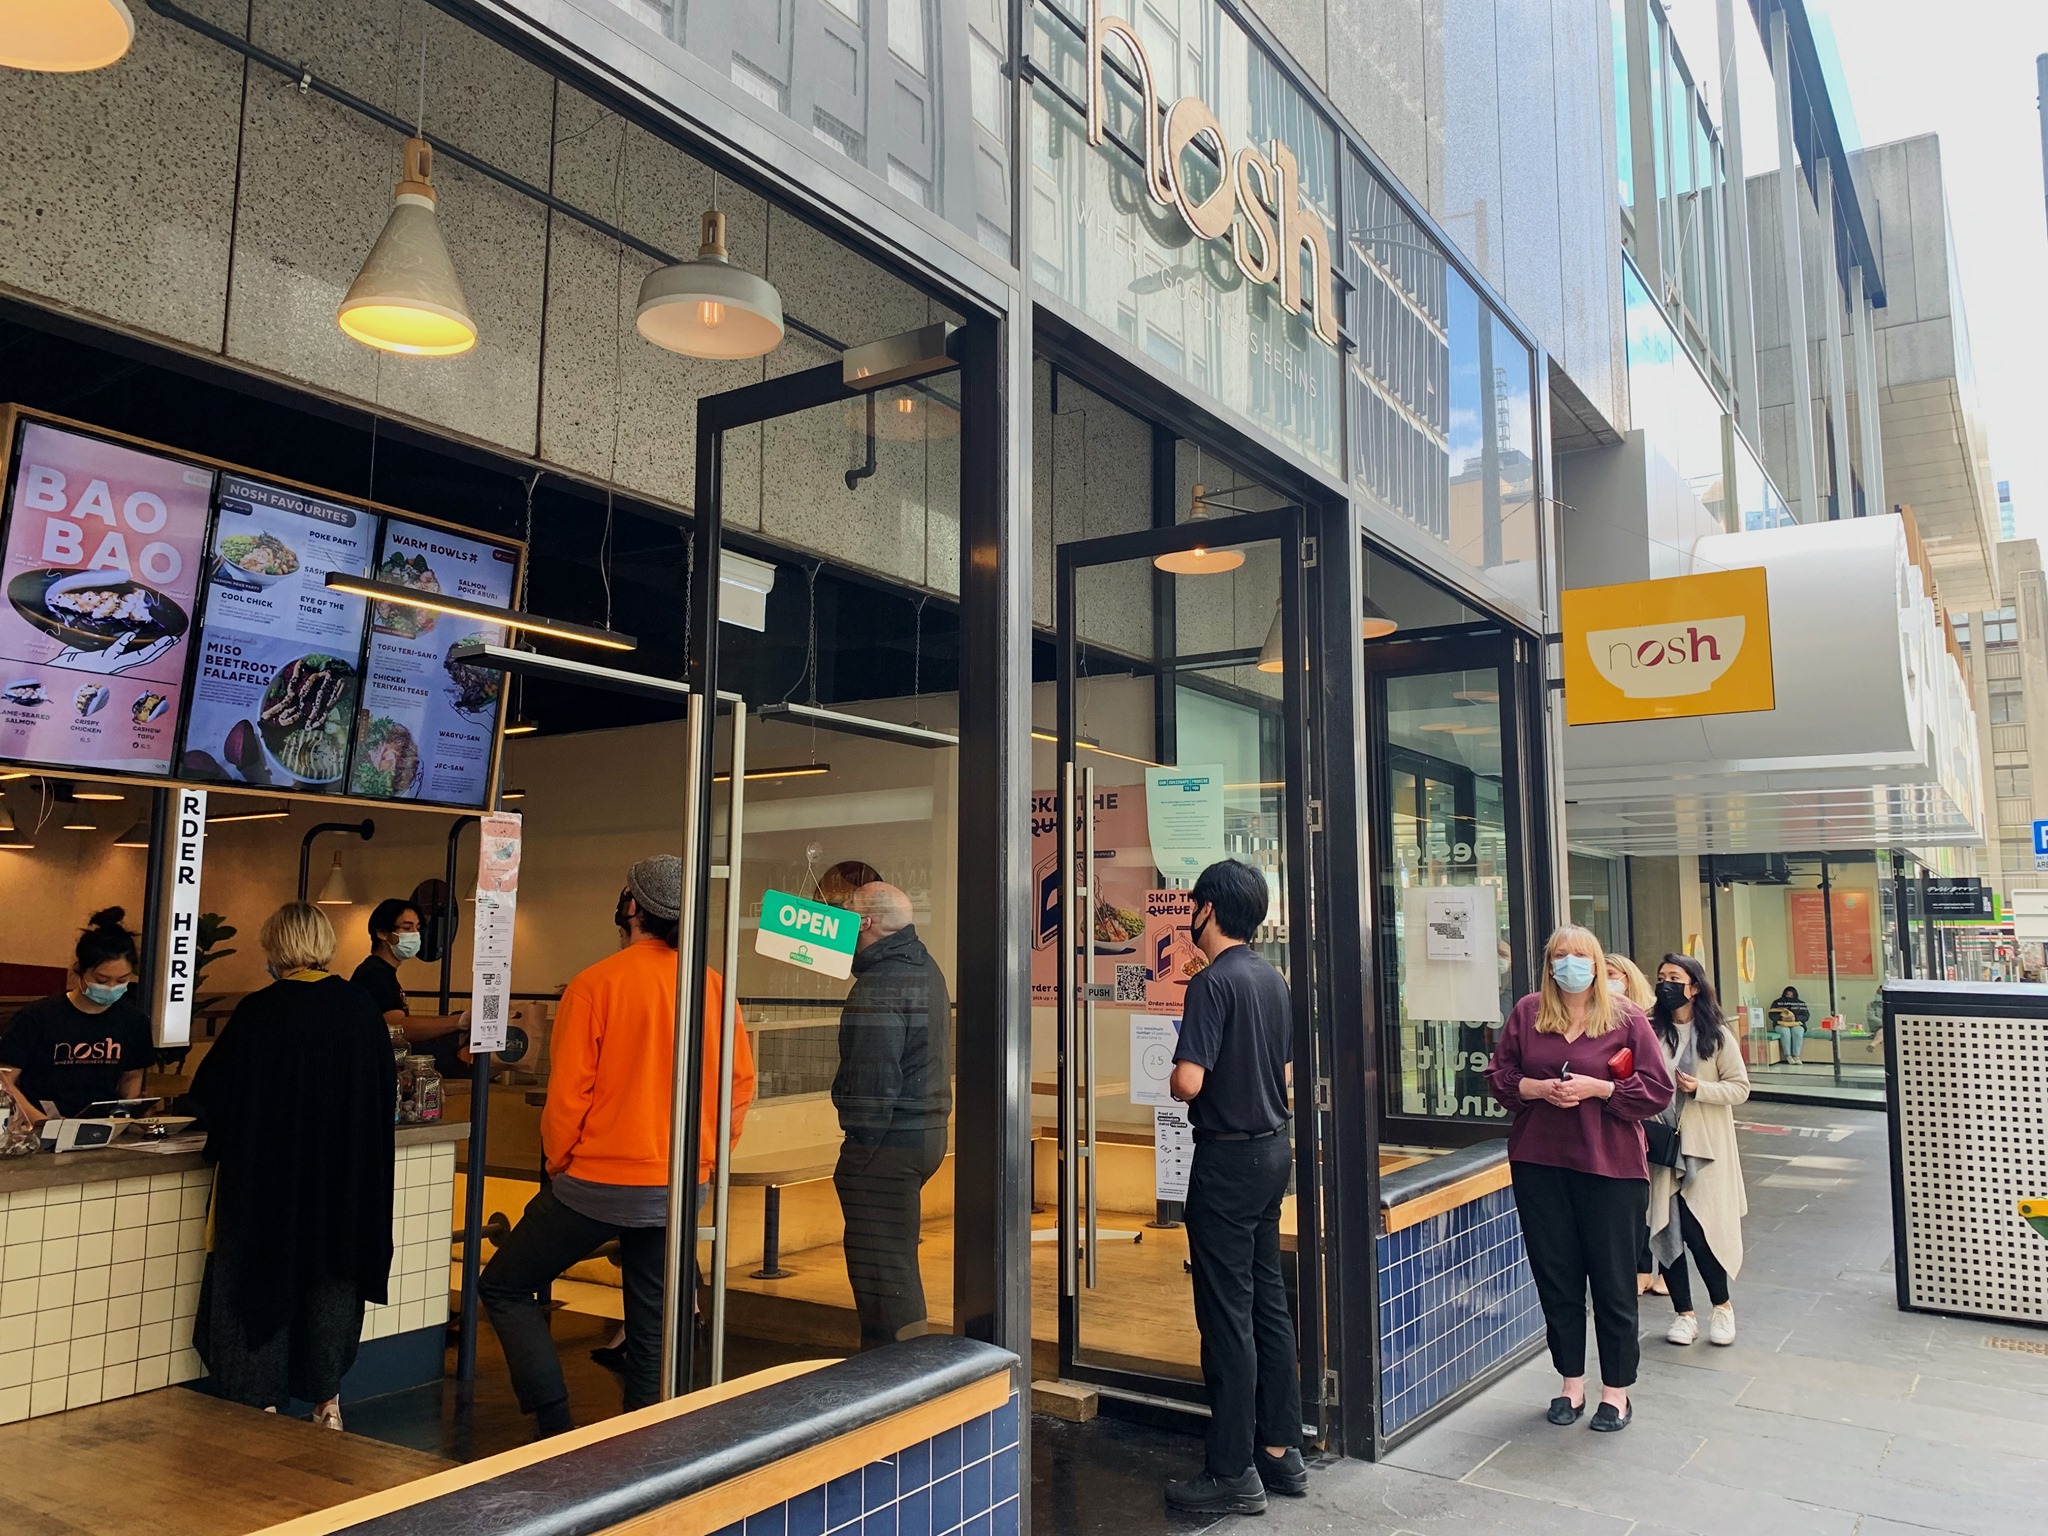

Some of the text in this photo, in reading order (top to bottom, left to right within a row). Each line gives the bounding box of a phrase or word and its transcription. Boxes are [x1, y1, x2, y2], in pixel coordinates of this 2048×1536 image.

[1085, 0, 1338, 348] nosh
[1074, 196, 1317, 399] WHERE GOODNESS BEGINS
[24, 464, 168, 534] BAO
[229, 484, 348, 524] NOSH FAVOURITES
[309, 530, 358, 548] POKE PARTY
[41, 517, 182, 584] BAO
[392, 533, 428, 551] WARM
[430, 544, 468, 561] BOWLS
[304, 566, 327, 576] SASH
[457, 585, 498, 600] POKE ABURI
[458, 579, 487, 591] SALMON
[221, 592, 274, 608] COOL CHICK
[300, 595, 345, 610] EYE OF THE
[299, 605, 323, 615] TIGER
[207, 641, 242, 656] MISO
[377, 643, 432, 659] TOFU TERI-SAN
[1608, 627, 1721, 670] nosh
[205, 654, 278, 675] BEETROOT
[203, 667, 271, 686] FALAFELS
[373, 672, 407, 684] CHICKEN
[372, 681, 430, 697] TERIYAKI TEASE
[0, 710, 51, 721] AME-SEARED
[5, 718, 37, 726] SALMON
[74, 719, 100, 727] CRISPY
[70, 725, 102, 734] CHICKEN
[132, 725, 162, 734] CASHEW
[137, 733, 156, 741] TOFU
[439, 730, 481, 742] WAGYU-SAN
[434, 763, 465, 772] JFC-SAN
[177, 789, 201, 886] RDER
[1148, 893, 1177, 903] SKIP
[1148, 905, 1191, 917] QUEUE
[779, 904, 840, 940] OPEN
[169, 912, 193, 1003] HERE
[1032, 983, 1051, 993] rder
[1088, 988, 1110, 997] PUSH
[53, 1037, 121, 1060] nosh
[1150, 1055, 1164, 1066] 25
